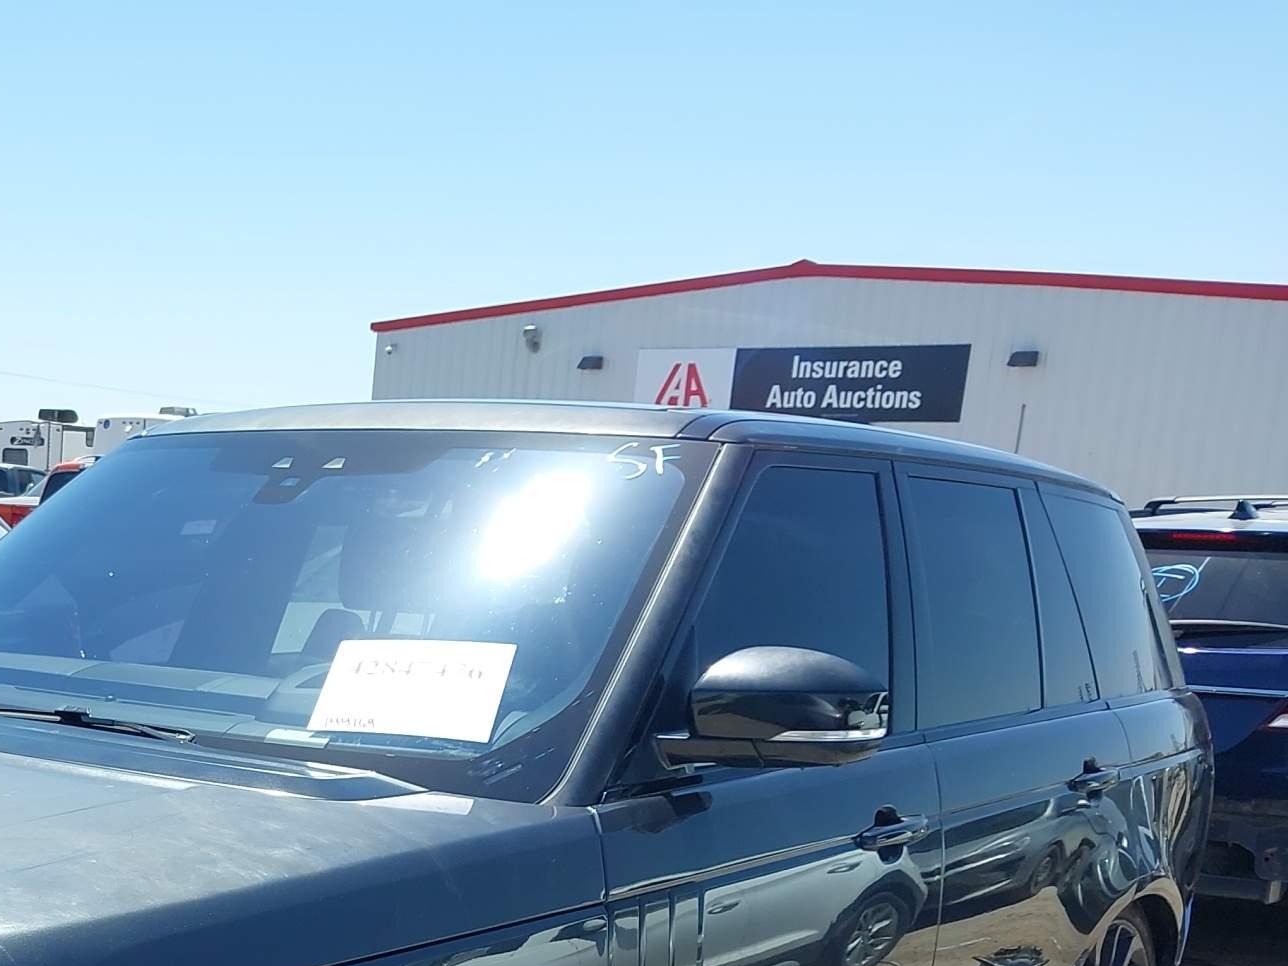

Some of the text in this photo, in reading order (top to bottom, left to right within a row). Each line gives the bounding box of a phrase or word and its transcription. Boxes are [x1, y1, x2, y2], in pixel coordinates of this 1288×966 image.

[791, 354, 903, 379] Insurance
[765, 385, 922, 410] Auto Auctions
